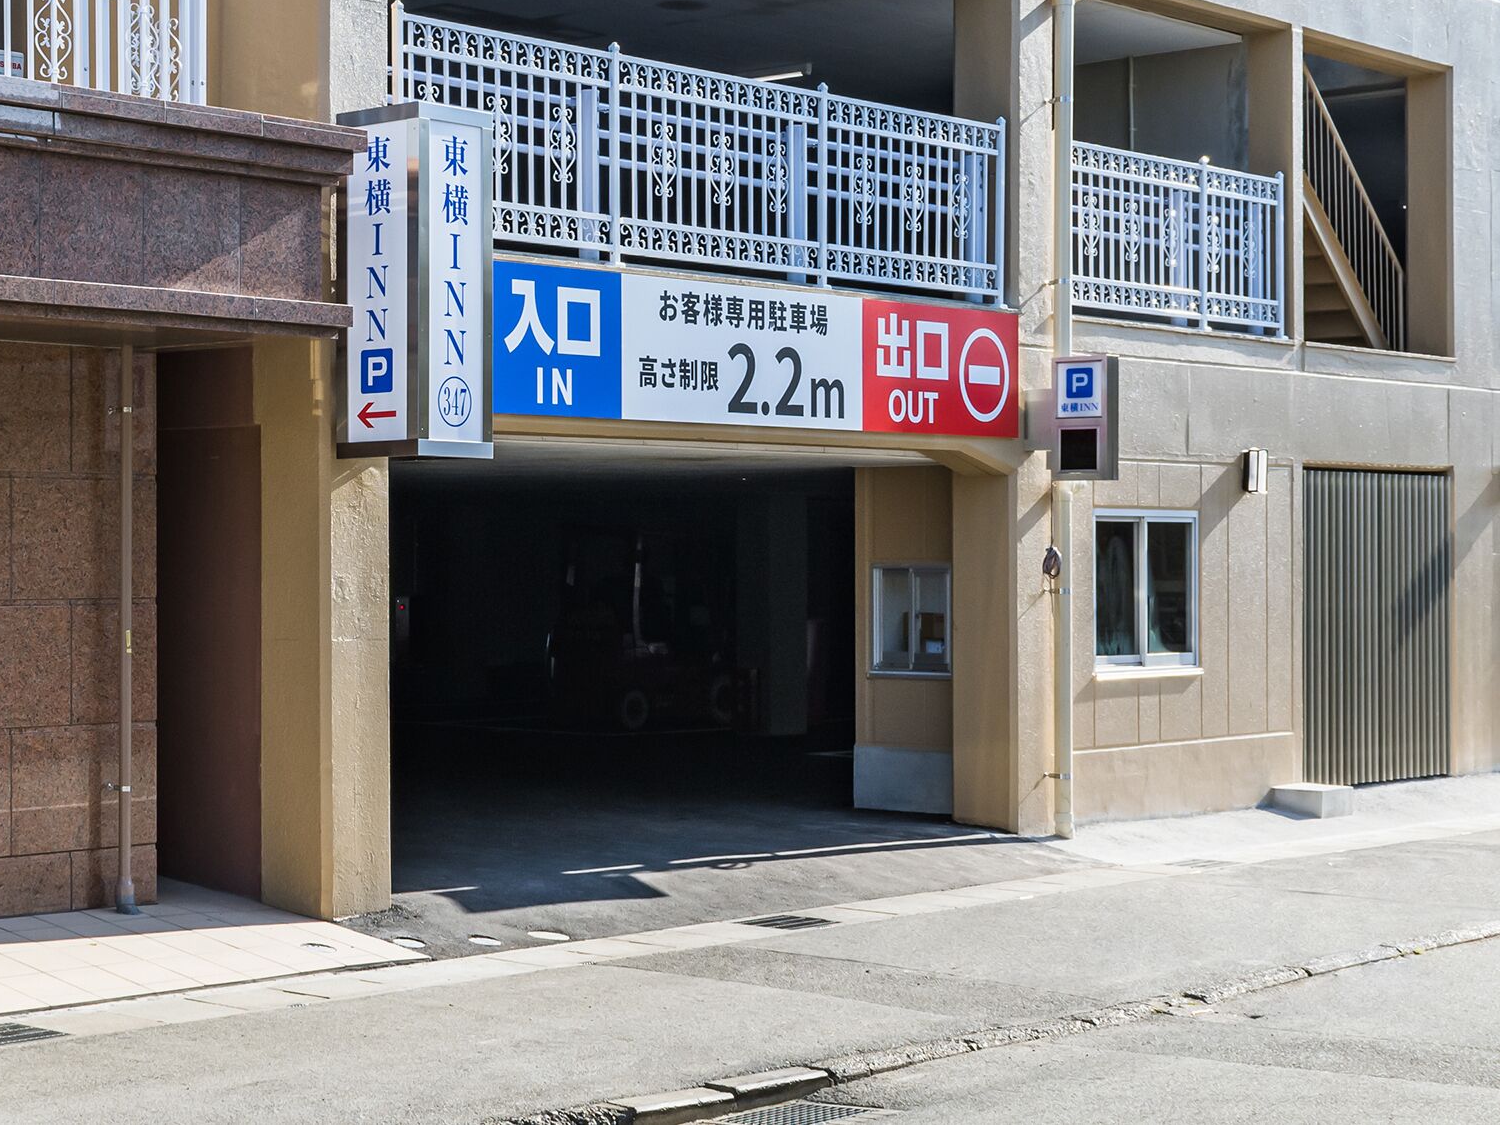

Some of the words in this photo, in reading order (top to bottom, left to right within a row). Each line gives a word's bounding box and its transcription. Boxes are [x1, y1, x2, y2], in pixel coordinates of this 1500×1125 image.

[365, 136, 392, 342] 東横INN
[442, 136, 469, 366] 東横INN
[504, 278, 601, 357] 入口
[659, 290, 828, 336] お客様専用駐車場
[876, 313, 949, 381] 出口
[367, 356, 388, 386] P
[536, 366, 573, 406] IN
[639, 355, 719, 392] 高さ制限
[727, 343, 845, 419] 2.2m
[1072, 373, 1088, 393] P
[443, 386, 467, 417] 347
[888, 388, 939, 424] OUT
